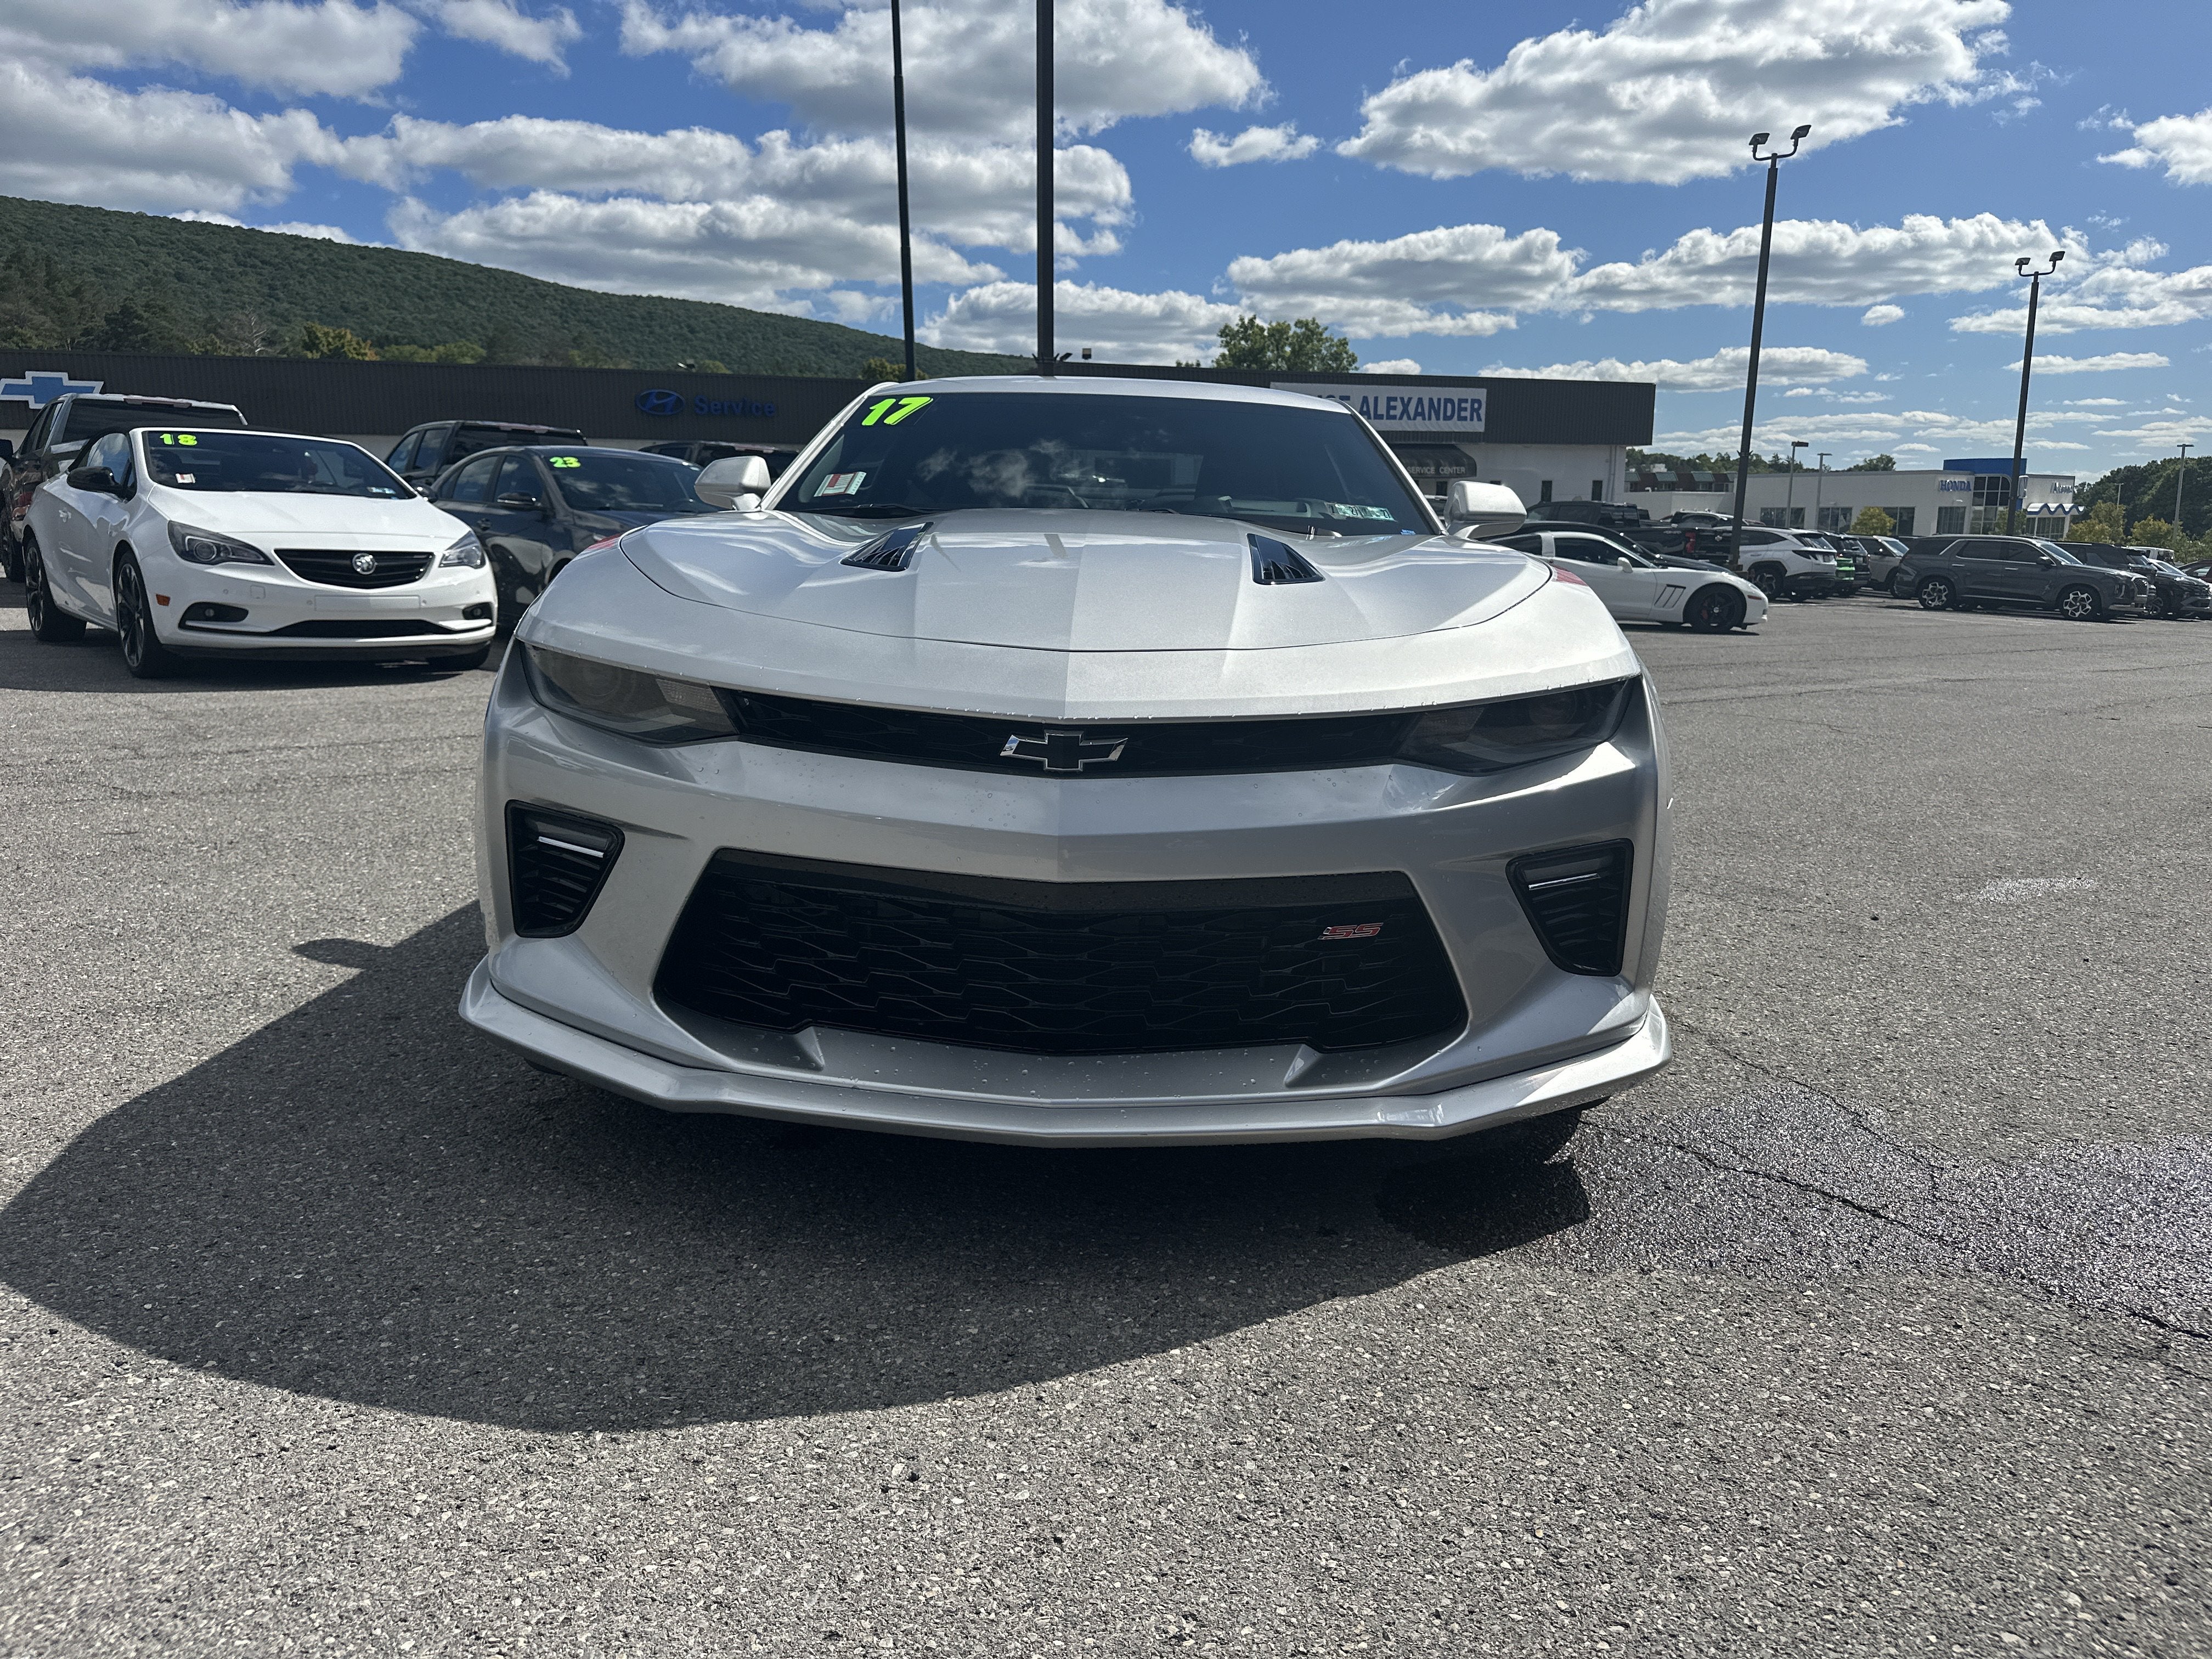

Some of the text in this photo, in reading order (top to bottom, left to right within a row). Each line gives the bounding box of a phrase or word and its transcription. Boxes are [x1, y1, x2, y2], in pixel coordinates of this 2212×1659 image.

[693, 394, 776, 415] Service
[861, 397, 934, 426] 17
[1359, 396, 1482, 422] ALEXANDER
[160, 433, 198, 445] 18
[550, 456, 581, 467] 23
[1939, 480, 1971, 492] HONDA
[1317, 922, 1384, 940] SS
